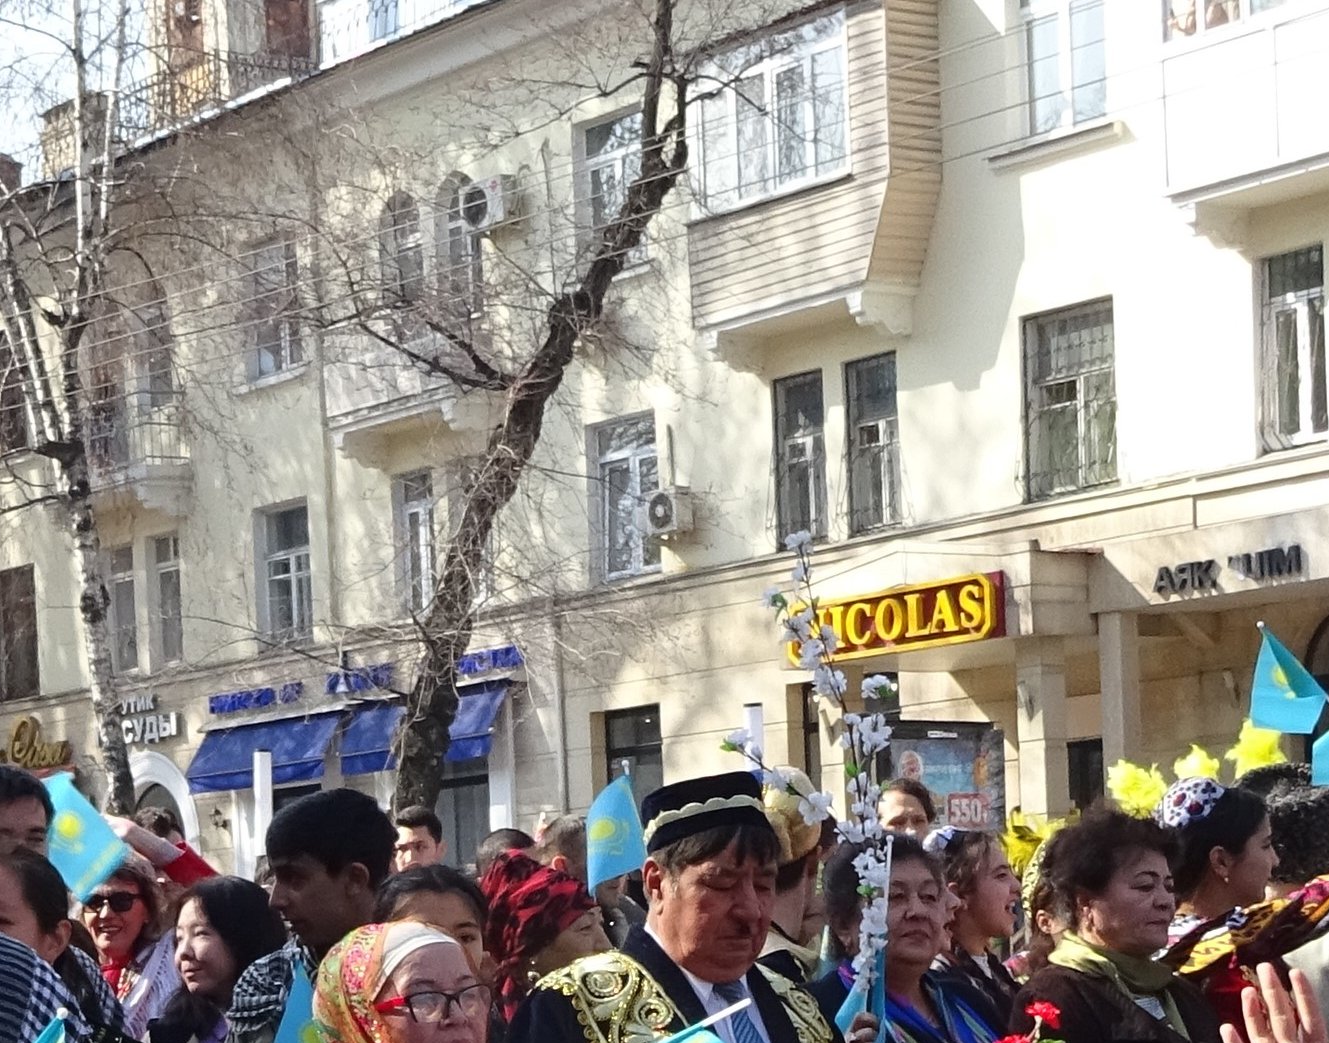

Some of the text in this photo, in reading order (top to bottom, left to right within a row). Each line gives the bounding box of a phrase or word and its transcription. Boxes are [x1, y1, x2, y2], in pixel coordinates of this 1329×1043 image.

[1153, 559, 1217, 594] АЯК
[120, 694, 154, 715] УТИК
[120, 711, 177, 744] СУДЫ
